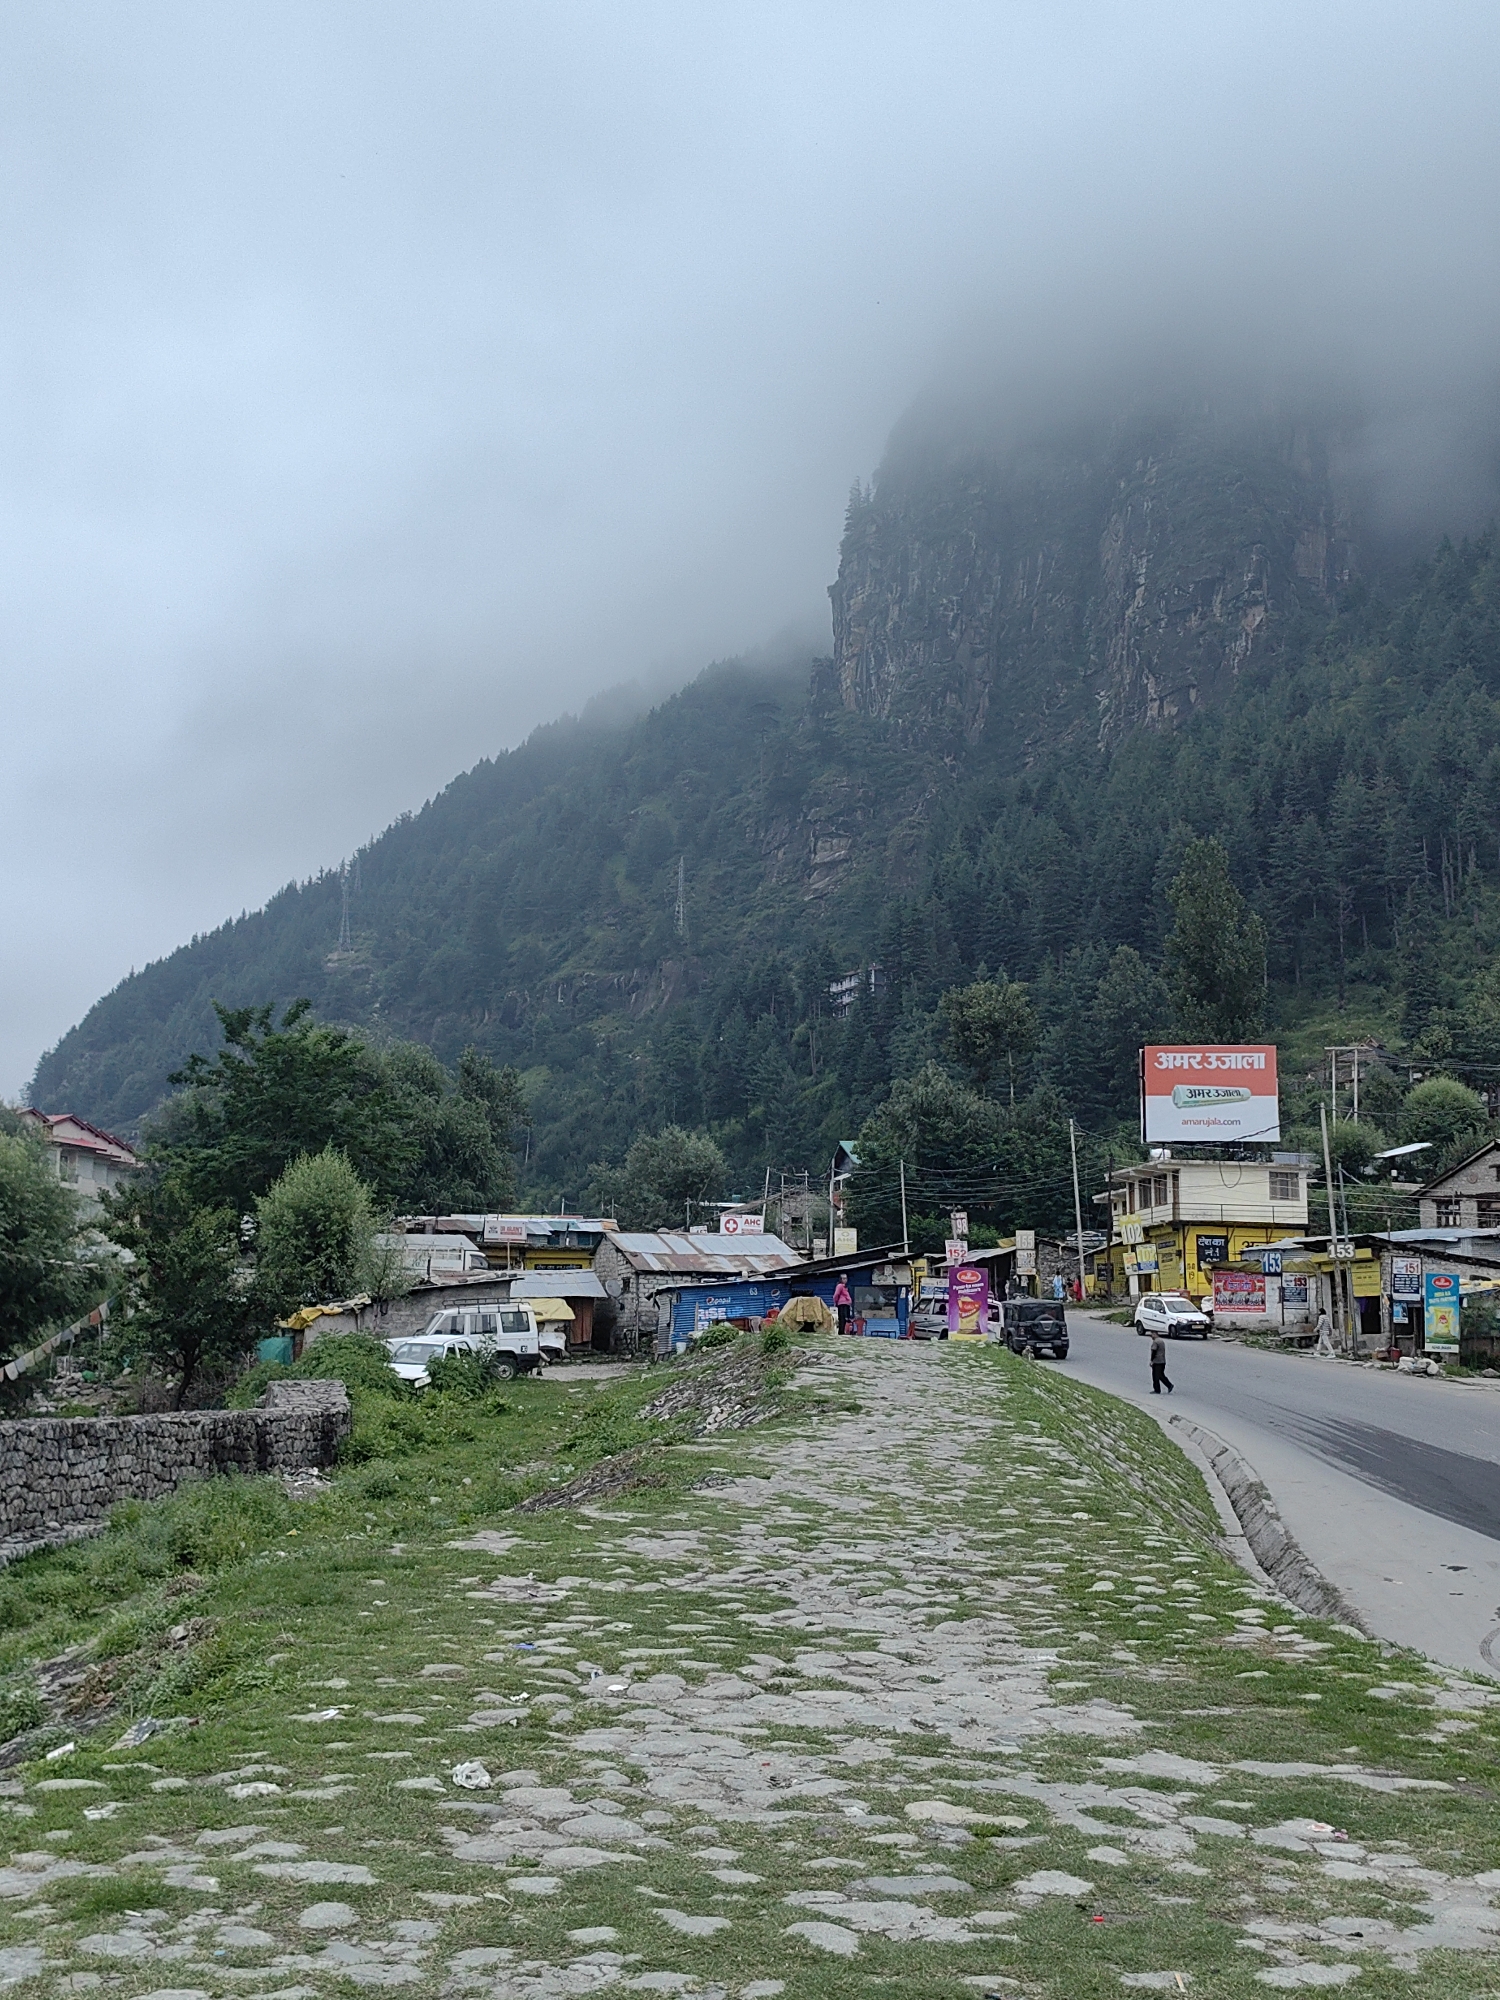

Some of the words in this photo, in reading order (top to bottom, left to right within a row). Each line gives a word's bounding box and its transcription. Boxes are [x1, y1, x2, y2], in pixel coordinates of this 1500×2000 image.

[1154, 1052, 1203, 1069] अमर
[1203, 1053, 1266, 1069] उजाला
[1186, 1088, 1213, 1099] अमर
[1213, 1089, 1242, 1098] उजाला
[1181, 1117, 1241, 1127] amarujala.com
[743, 1218, 761, 1226] AHC
[1120, 1223, 1142, 1244] 102
[1017, 1235, 1033, 1249] 155
[948, 1249, 967, 1257] 152
[1328, 1244, 1355, 1258] 153
[1263, 1252, 1282, 1273] 153
[1404, 1263, 1420, 1274] 151
[1293, 1276, 1307, 1287] 153
